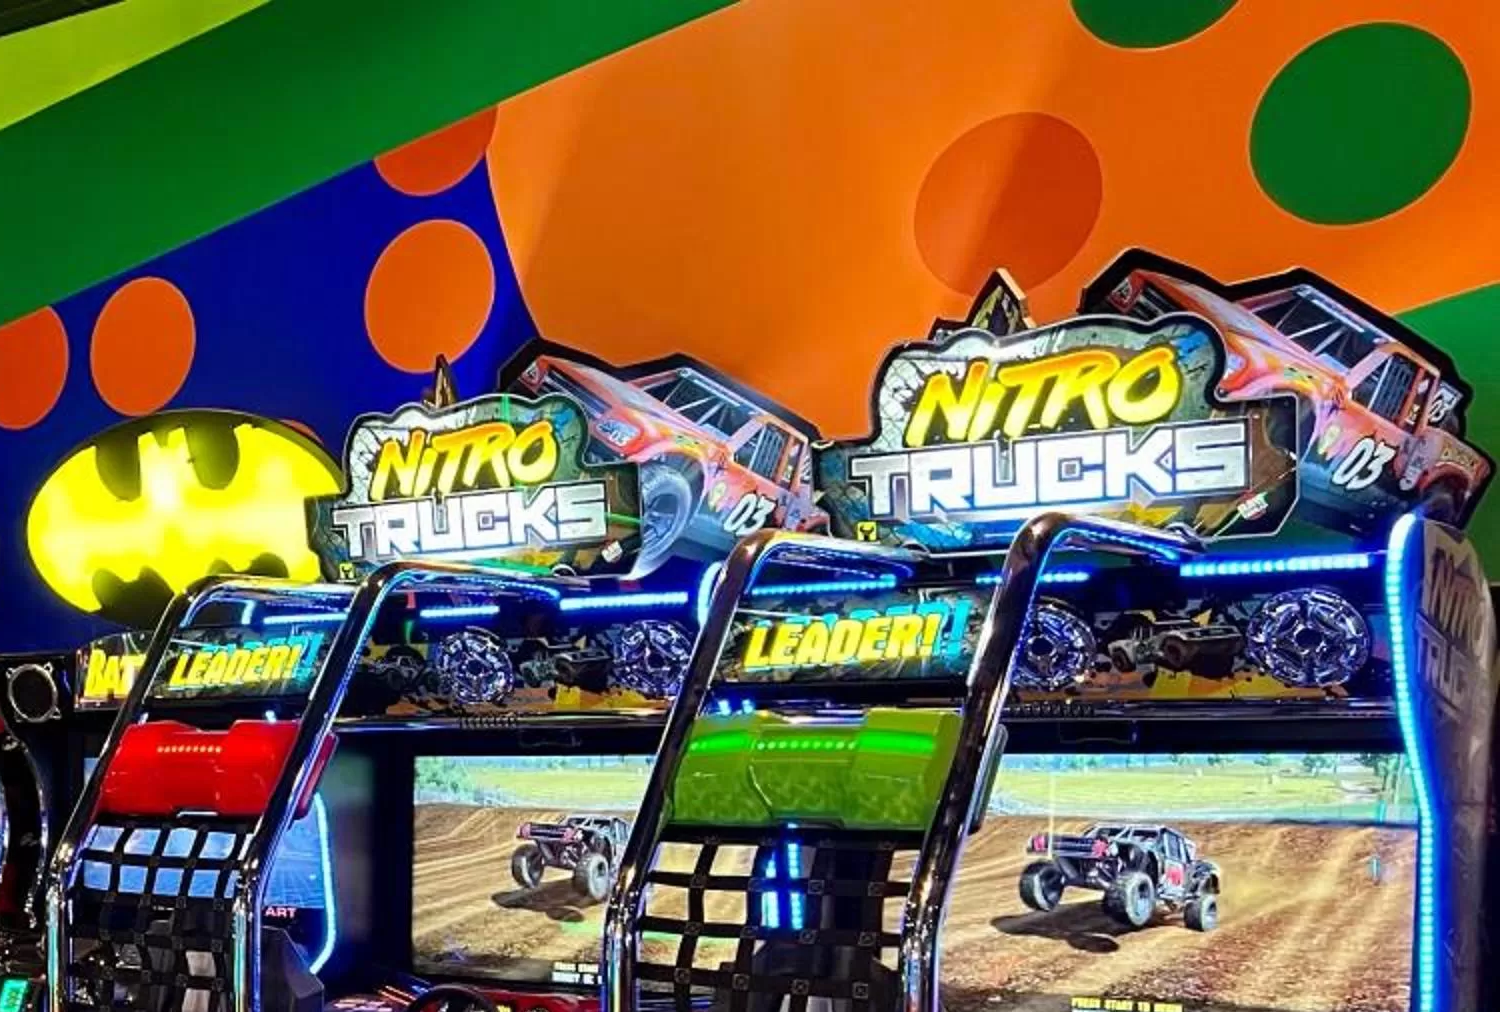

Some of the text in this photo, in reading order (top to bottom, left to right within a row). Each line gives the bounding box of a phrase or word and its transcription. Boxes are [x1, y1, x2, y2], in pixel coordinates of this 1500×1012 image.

[849, 419, 1248, 518] TRUCKS
[1332, 438, 1396, 491] 03
[331, 482, 607, 559] TRUCKS
[724, 492, 776, 537] 03
[168, 644, 302, 688] LEADER!
[744, 613, 942, 669] LEADER!
[264, 906, 297, 919] ART
